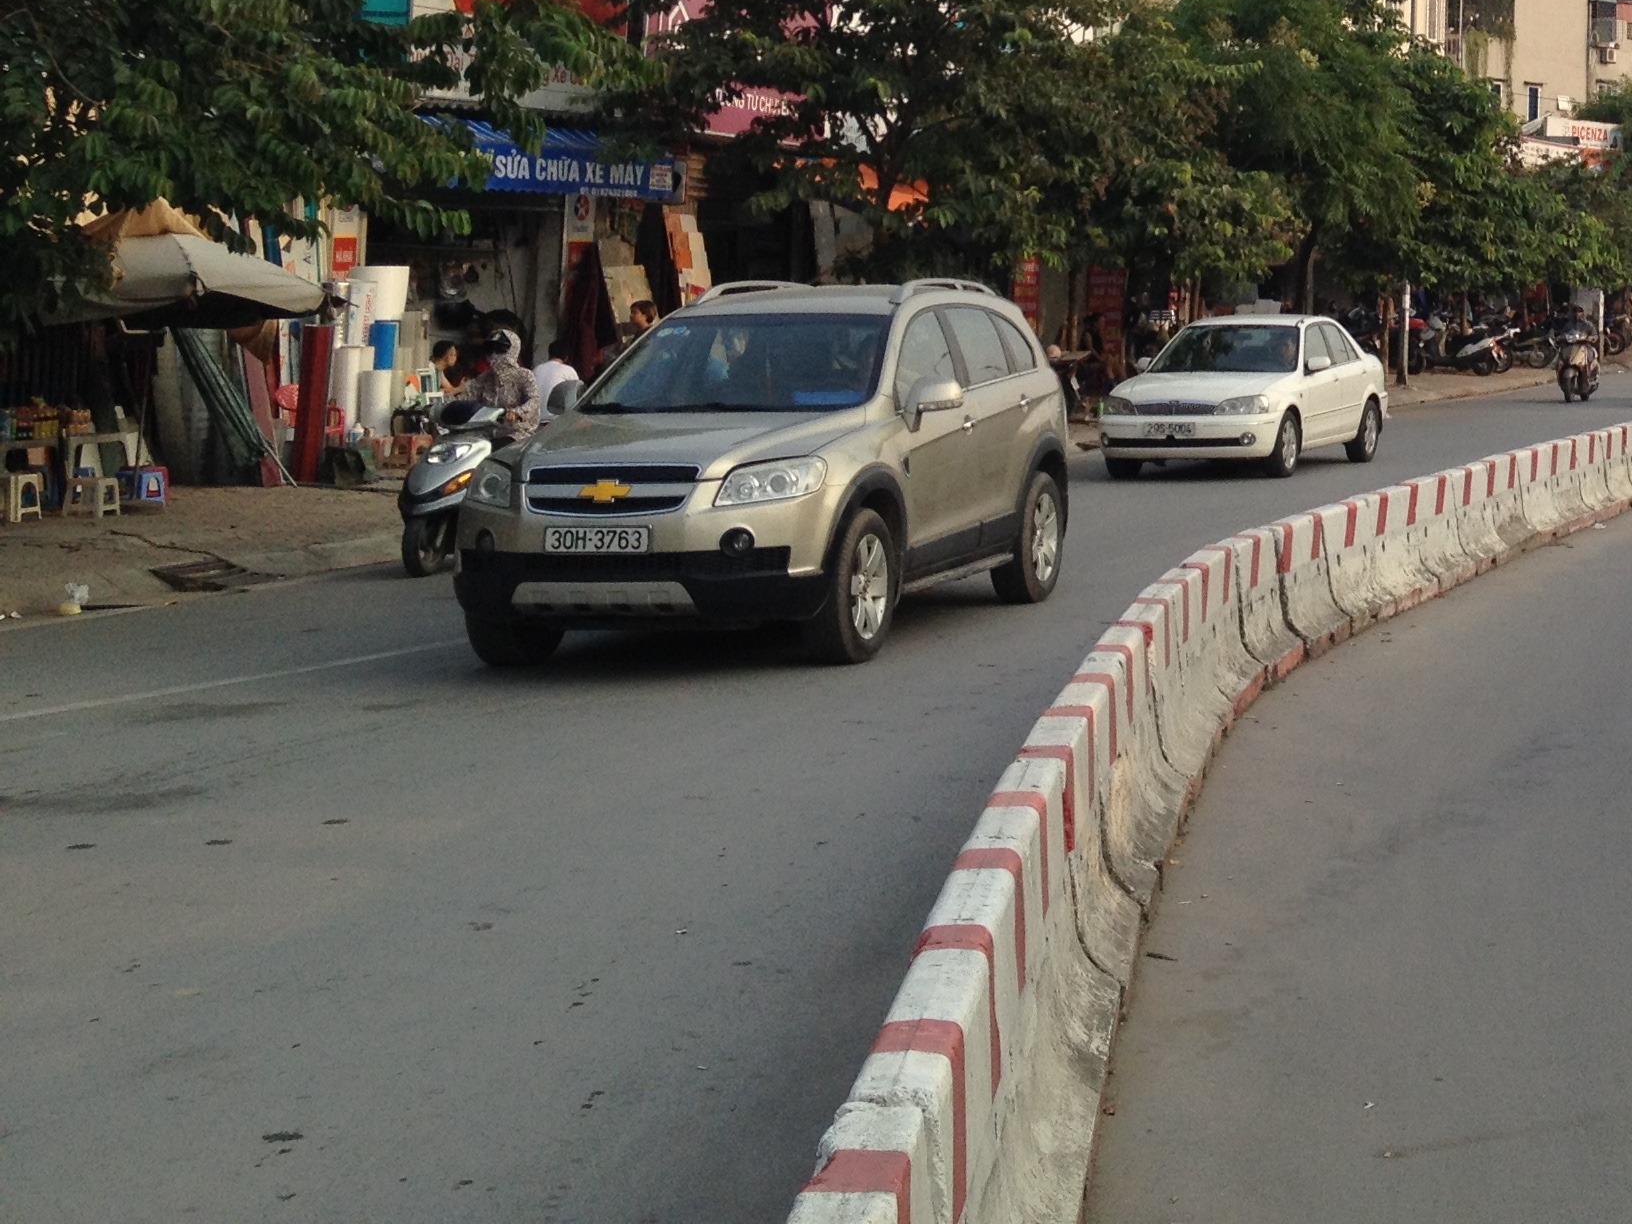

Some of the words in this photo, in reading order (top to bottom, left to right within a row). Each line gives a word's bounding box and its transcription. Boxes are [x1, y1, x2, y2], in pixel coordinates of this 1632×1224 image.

[1571, 125, 1608, 142] PICENZA
[494, 148, 530, 180] SỬA
[535, 155, 580, 183] CHỮA
[585, 161, 605, 184] XE
